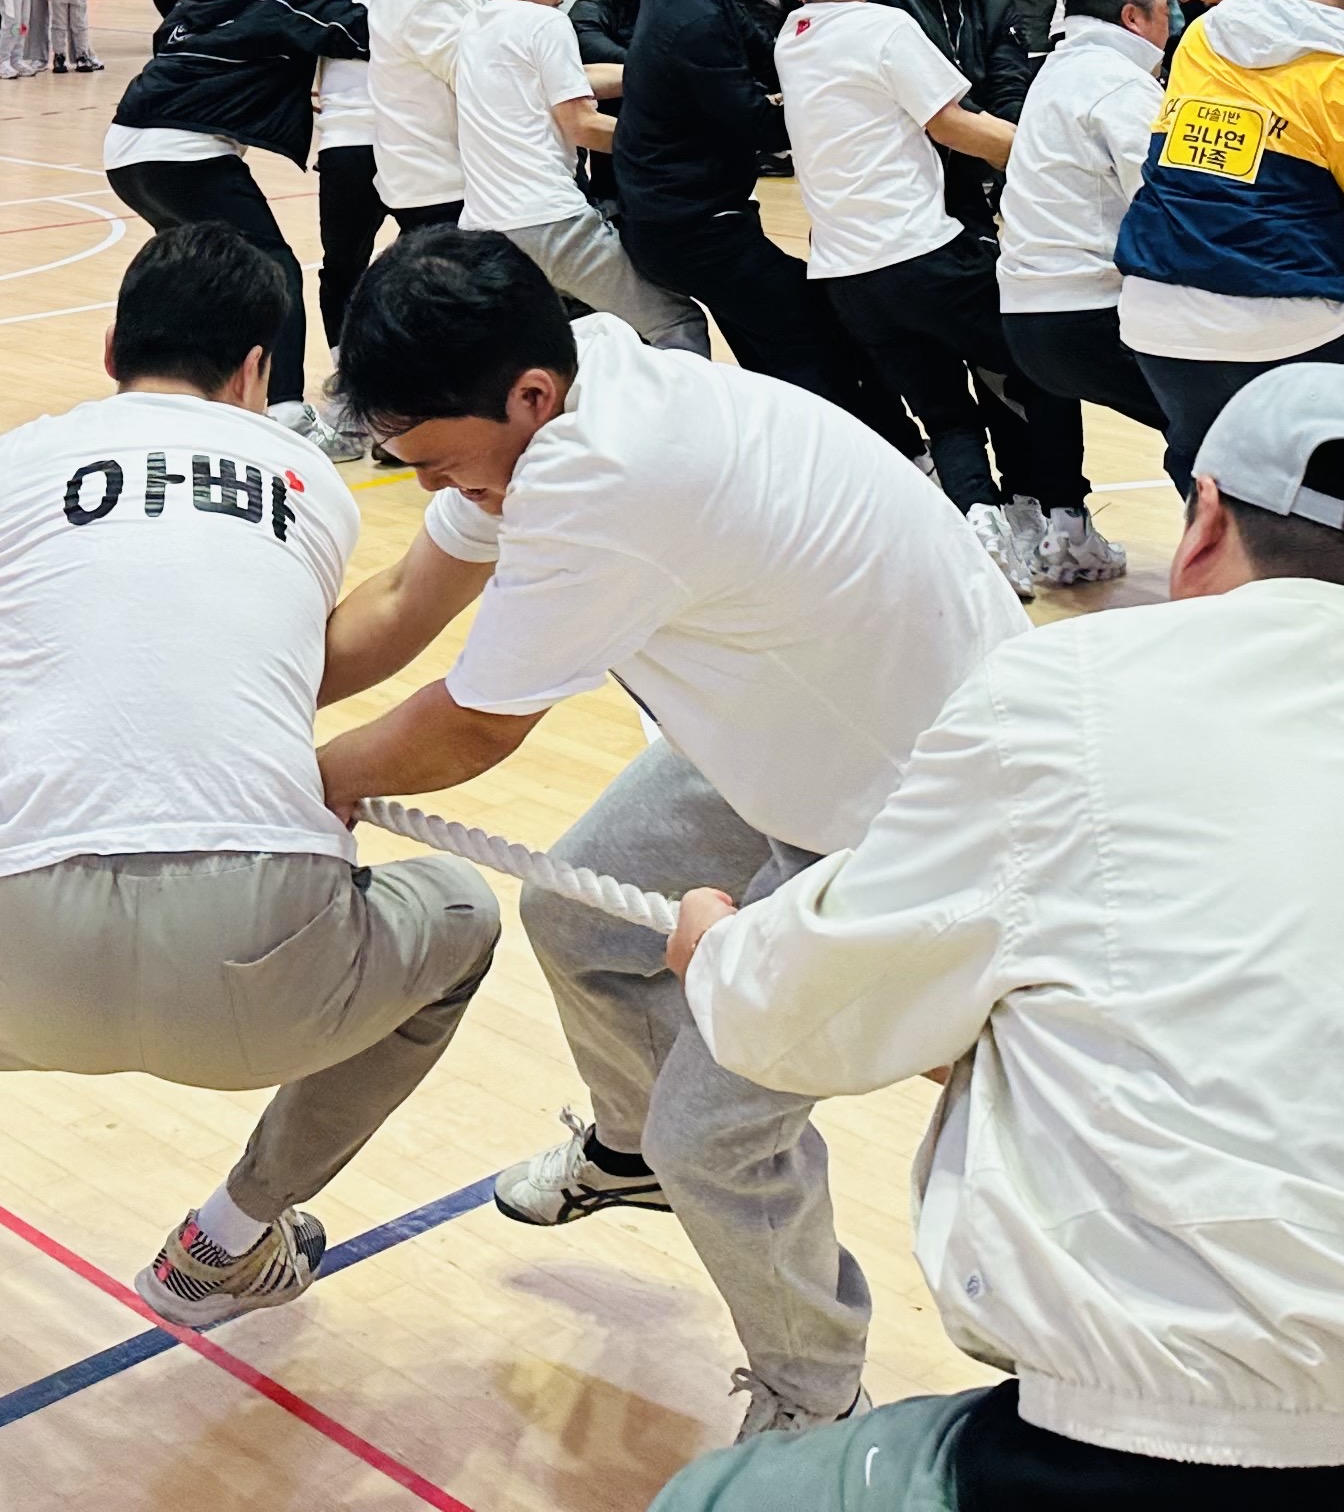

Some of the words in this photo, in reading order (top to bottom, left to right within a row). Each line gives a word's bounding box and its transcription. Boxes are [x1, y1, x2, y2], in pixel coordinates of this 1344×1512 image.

[1197, 106, 1241, 125] 다솔1반
[1183, 123, 1246, 152] 김나연
[1188, 144, 1228, 170] 가족
[63, 451, 297, 543] 아빠
